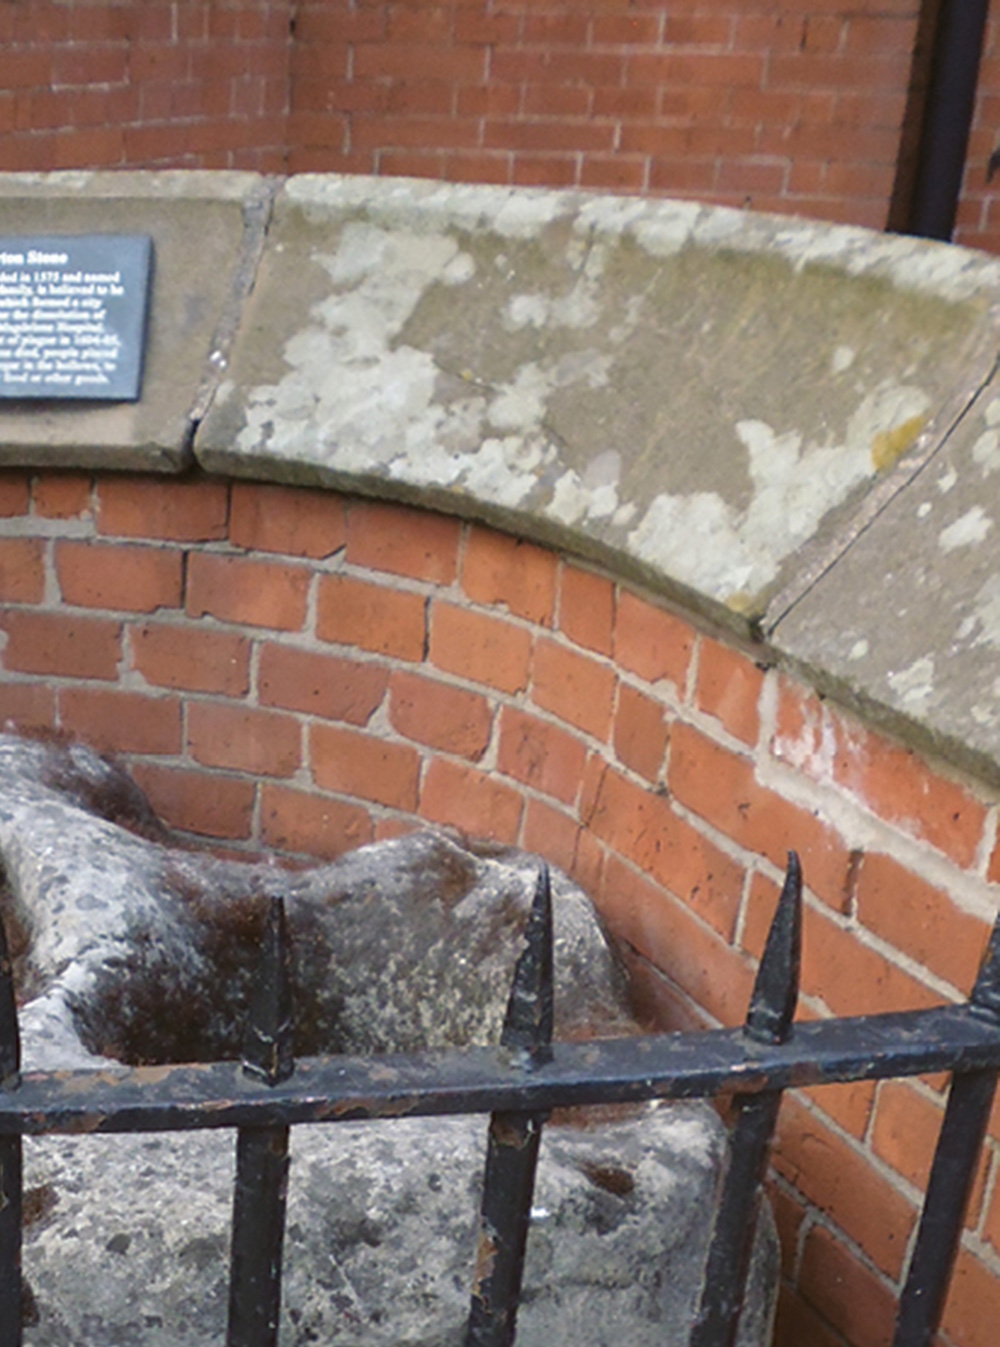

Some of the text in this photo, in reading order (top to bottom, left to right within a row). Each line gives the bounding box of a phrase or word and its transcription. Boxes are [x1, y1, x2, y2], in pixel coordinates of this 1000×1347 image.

[27, 250, 68, 264] Stone
[20, 273, 30, 281] in
[34, 272, 59, 281] 1575
[63, 272, 81, 281] and
[85, 272, 120, 281] named
[38, 285, 46, 294] is
[50, 284, 94, 294] believed
[97, 285, 107, 294] to
[111, 284, 124, 294] be
[32, 297, 70, 307] formed
[82, 298, 102, 308] city
[13, 310, 28, 319] the
[93, 309, 106, 319] of
[7, 334, 20, 345] of
[22, 335, 56, 346] plague
[60, 335, 70, 345] in
[43, 348, 78, 359] people
[82, 348, 118, 359] placed
[24, 361, 33, 370] in
[38, 361, 52, 370] the
[4, 373, 28, 382] food
[45, 373, 71, 383] other
